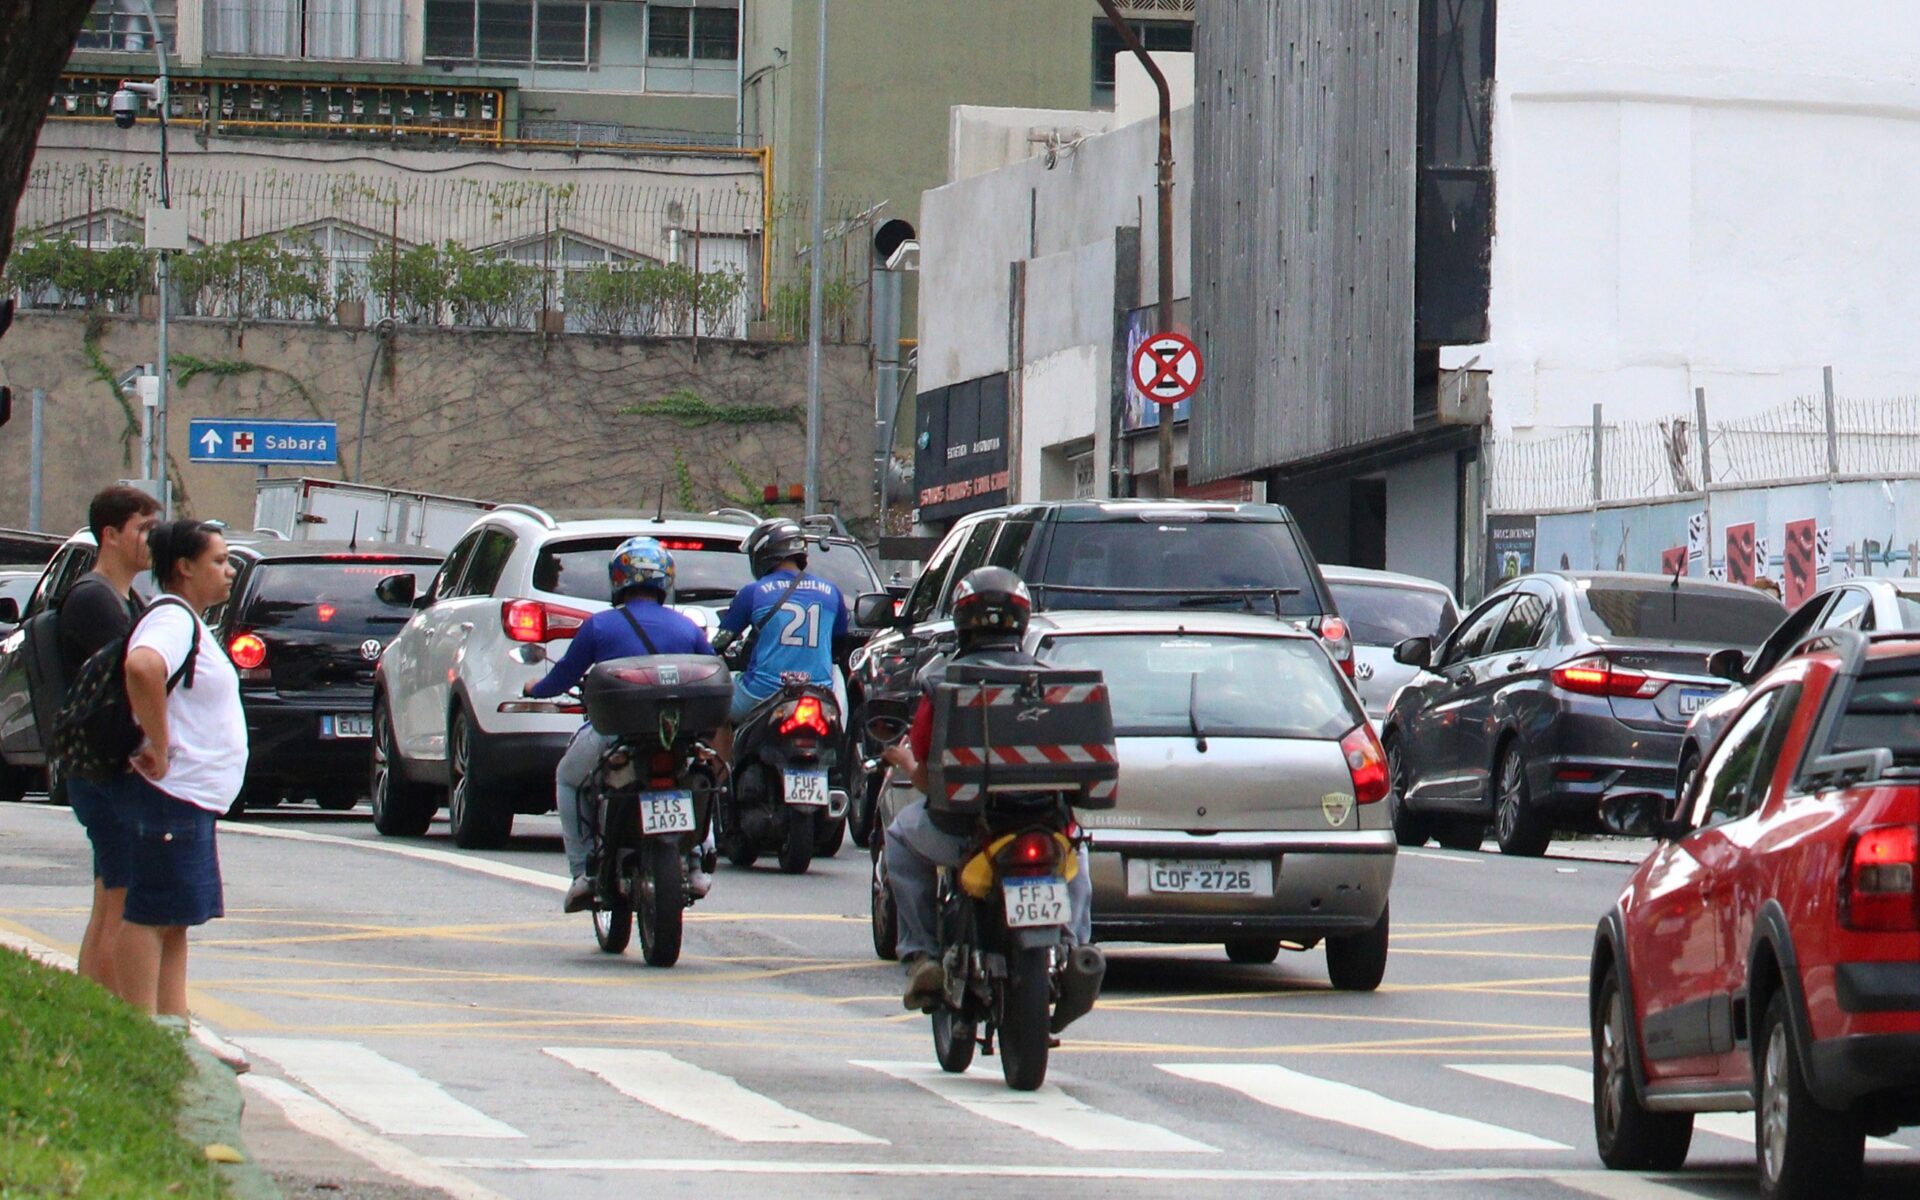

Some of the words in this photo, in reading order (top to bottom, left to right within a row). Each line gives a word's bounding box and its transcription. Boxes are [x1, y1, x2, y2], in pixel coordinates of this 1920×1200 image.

[265, 434, 328, 450] Sabará
[780, 601, 821, 648] 21
[795, 776, 818, 789] FUF
[791, 789, 823, 801] 6C74
[651, 799, 681, 814] EIS
[648, 813, 688, 830] 1A93
[1095, 815, 1143, 826] ELEMENT
[1019, 886, 1055, 902] FFJ
[1015, 902, 1062, 920] 9G47
